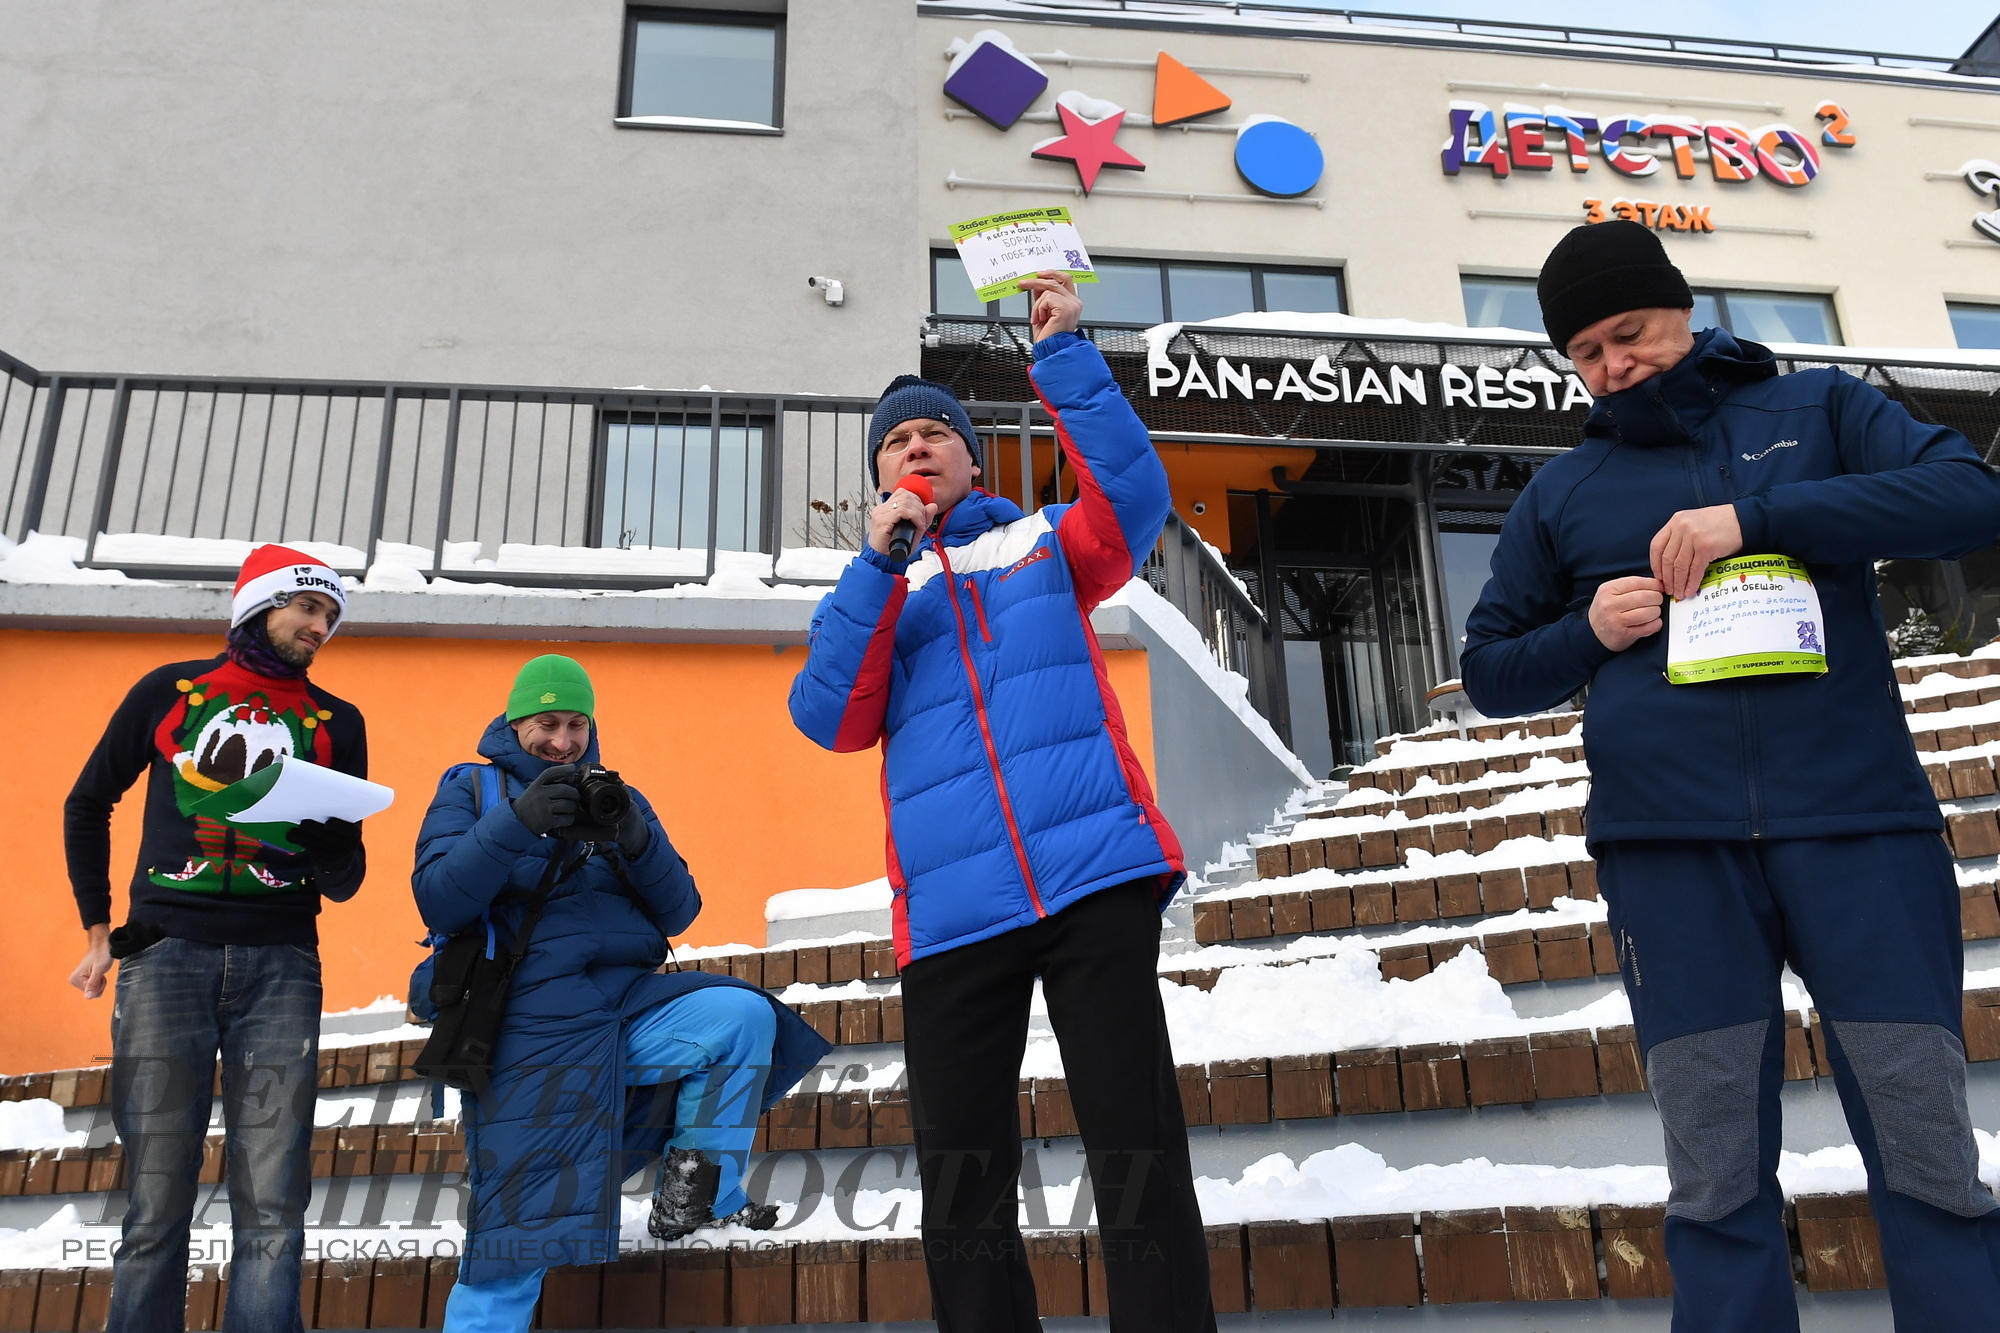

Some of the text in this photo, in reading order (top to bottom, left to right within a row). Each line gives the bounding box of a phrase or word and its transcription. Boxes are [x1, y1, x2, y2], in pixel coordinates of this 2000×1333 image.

[1442, 103, 1856, 189] ДЕТСТВО 2
[958, 219, 989, 231] Забег
[992, 210, 1044, 223] обещаний
[1583, 199, 1716, 233] 3 ЭТАЖ
[993, 231, 1009, 239] БЕГУ
[1002, 234, 1042, 248] БОРИСЬ
[990, 257, 999, 267] И
[1149, 355, 1427, 406] PAN-ASIAN
[1751, 440, 1798, 461] Columbia
[1716, 558, 1785, 574] обещаний
[1711, 587, 1729, 600] БЕГУ
[1796, 620, 1817, 635] 20
[1742, 660, 1785, 669] SUPERSPORT
[1629, 945, 1642, 986] Columbia
